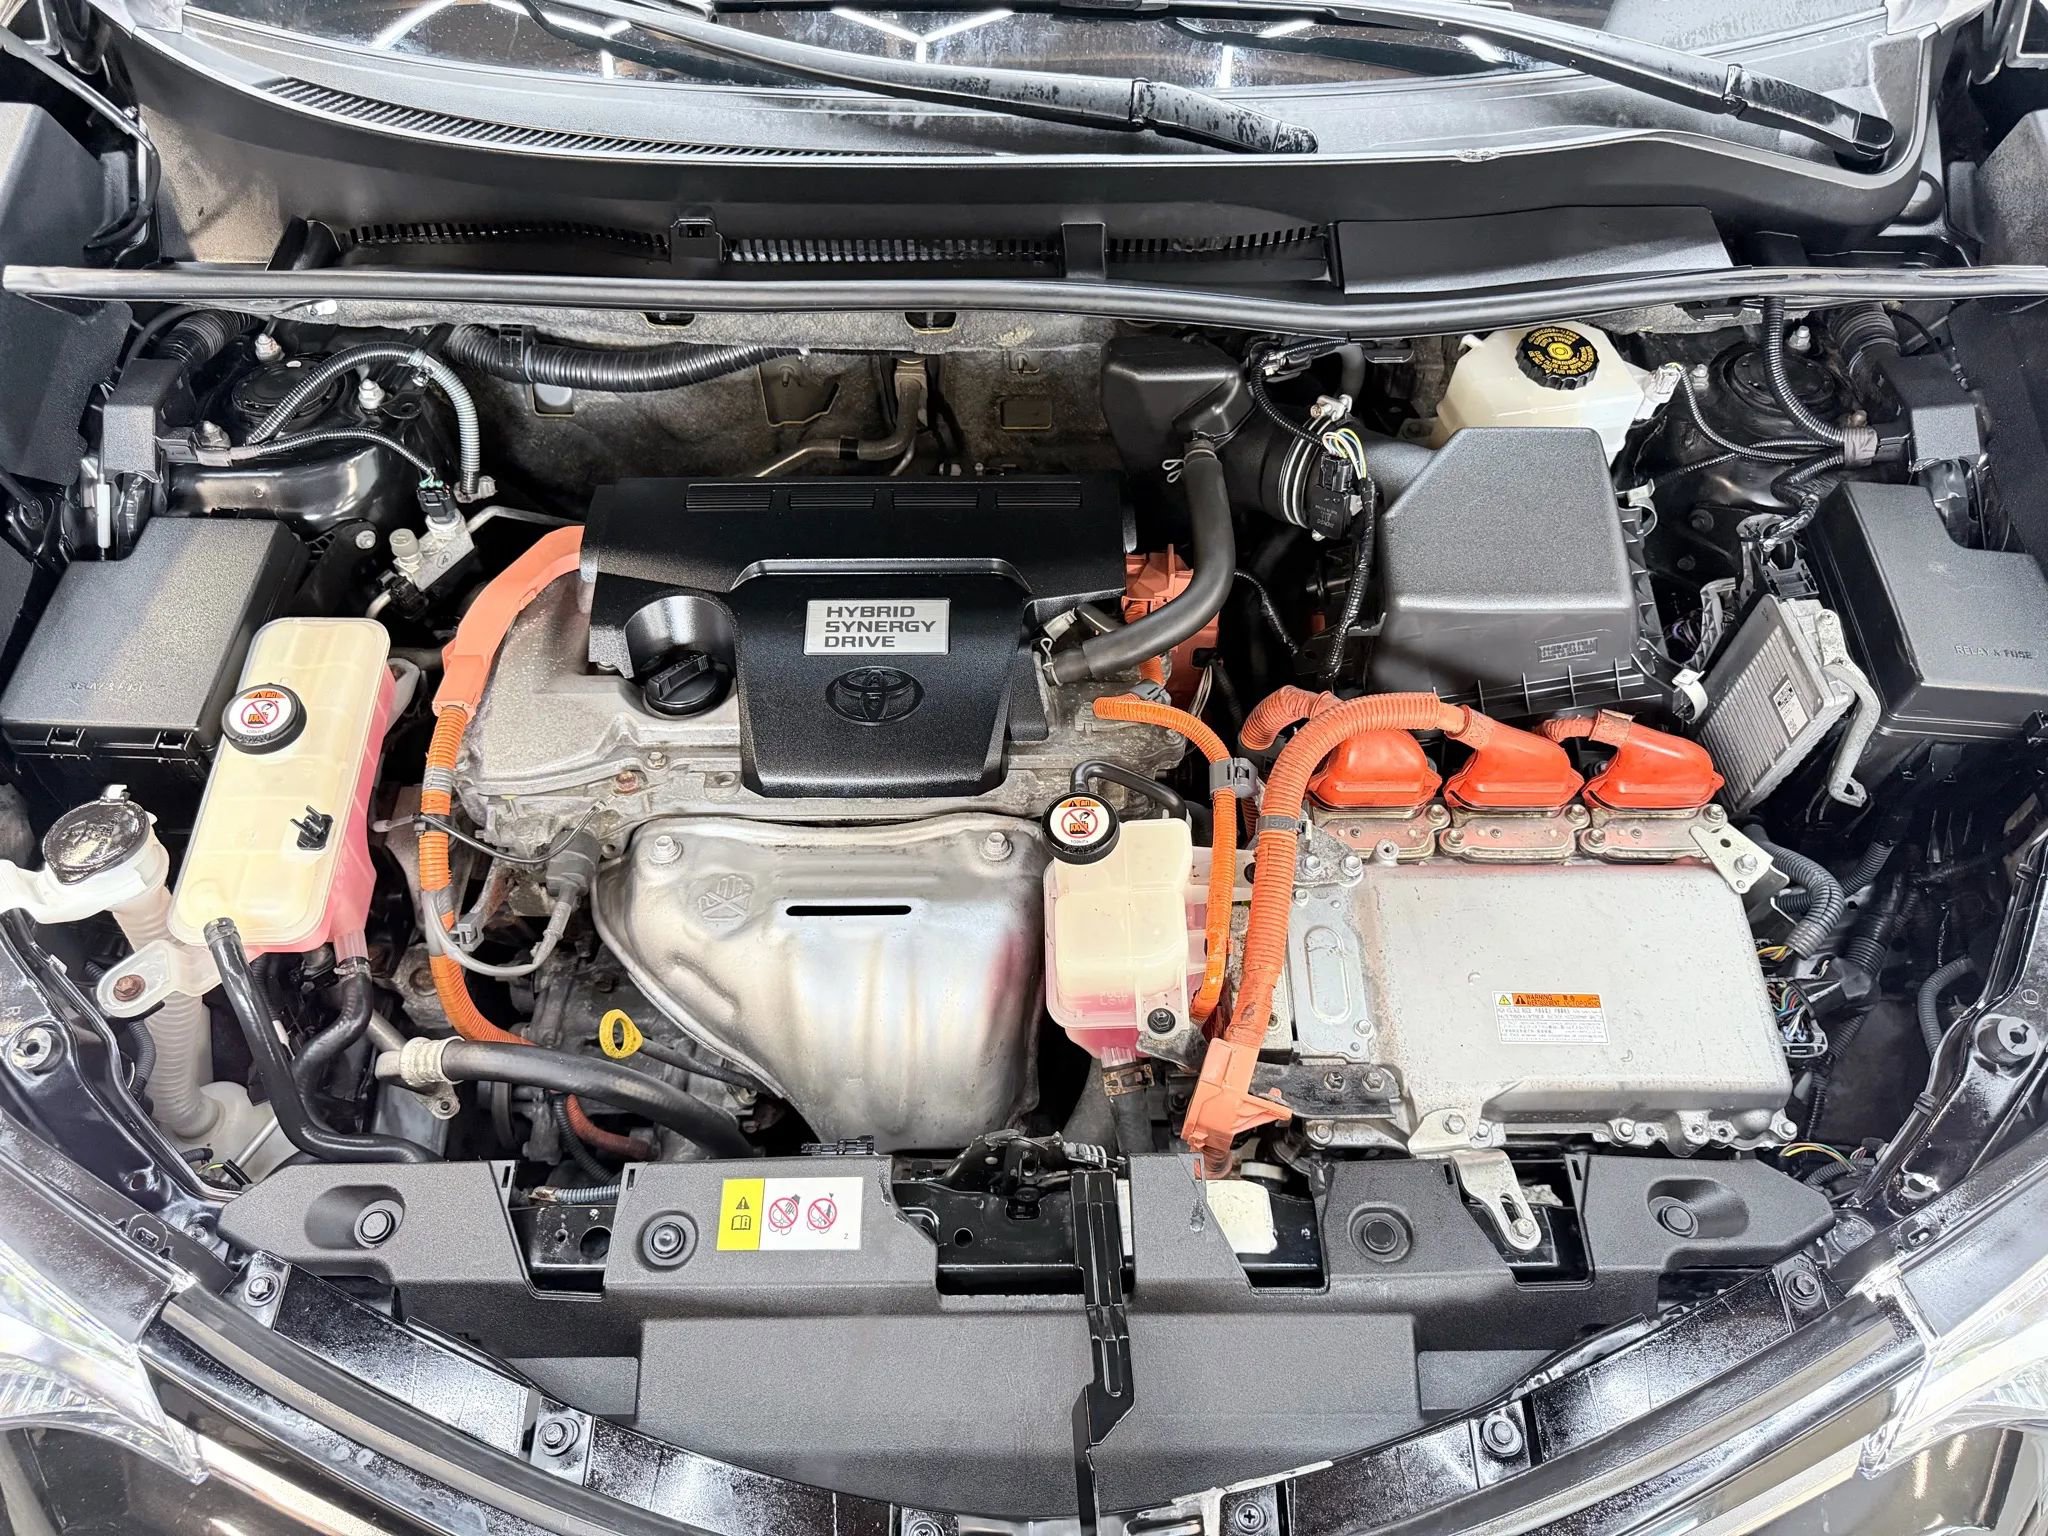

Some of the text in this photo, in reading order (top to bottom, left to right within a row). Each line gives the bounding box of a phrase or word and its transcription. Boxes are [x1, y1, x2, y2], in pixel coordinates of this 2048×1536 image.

[827, 606, 915, 618] HYBRID
[825, 620, 937, 633] SYNERGY
[824, 636, 896, 648] DRIVE
[1954, 645, 1990, 657] RELAY
[2003, 648, 2034, 659] FUSE
